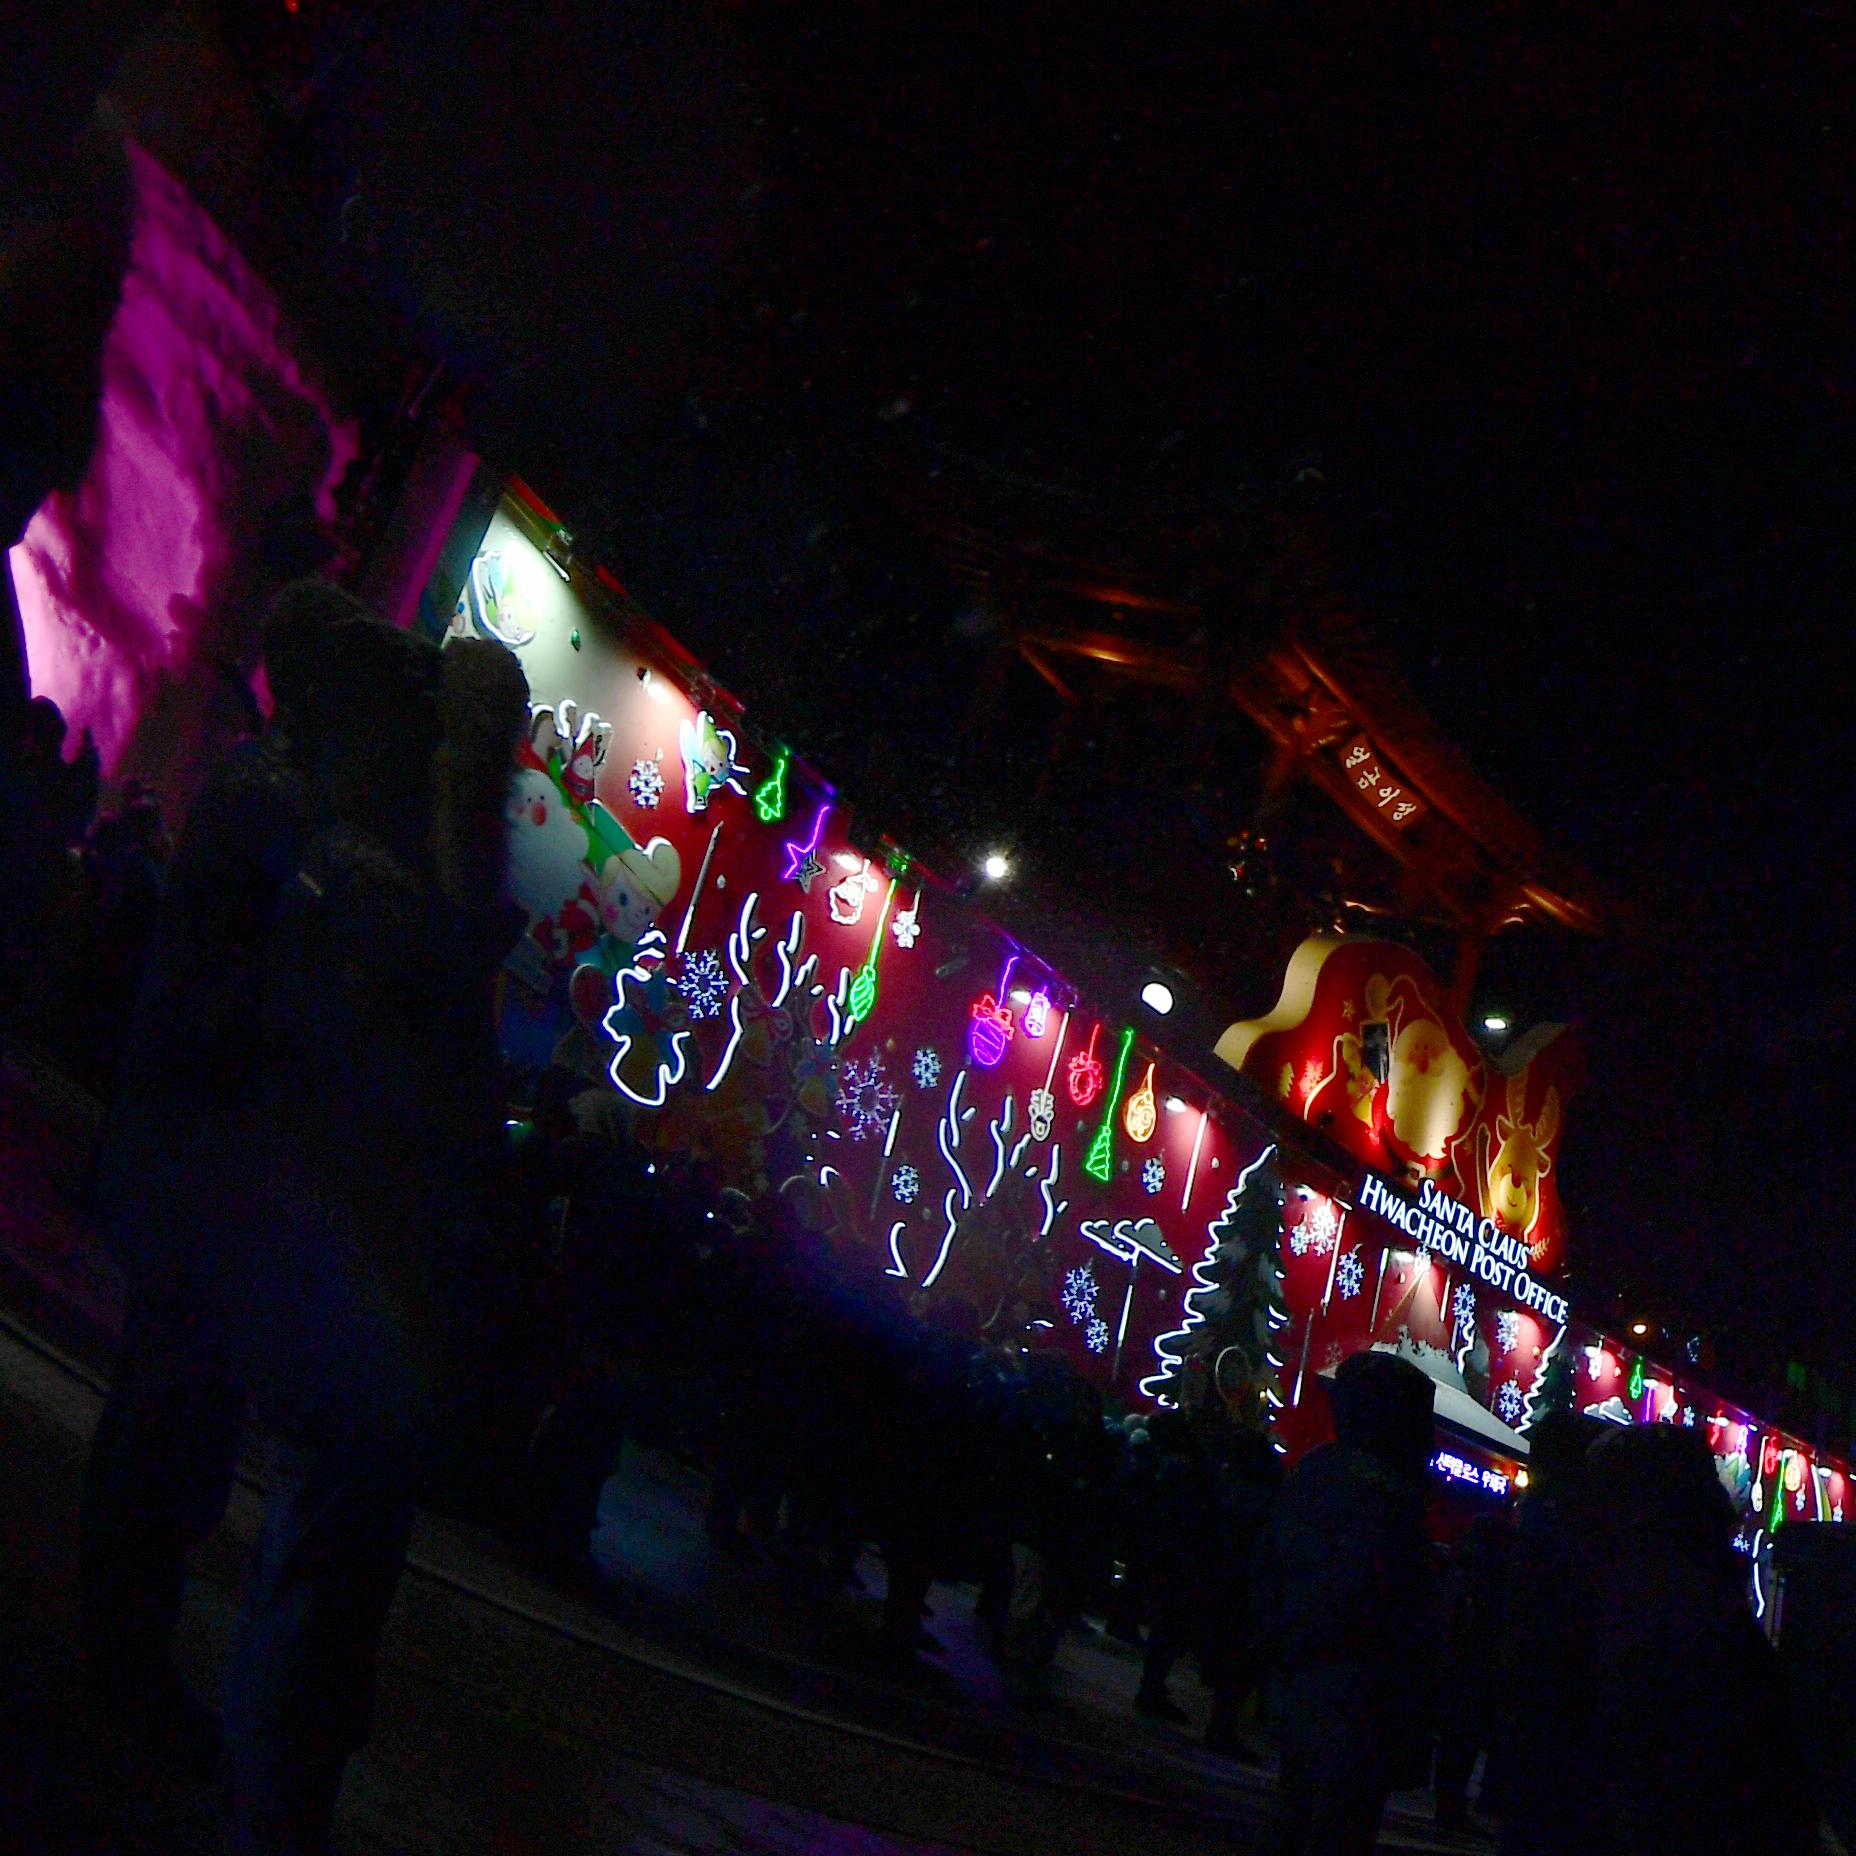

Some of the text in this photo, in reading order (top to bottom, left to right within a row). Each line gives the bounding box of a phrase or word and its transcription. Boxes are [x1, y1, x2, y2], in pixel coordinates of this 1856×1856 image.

[1345, 745, 1417, 821] 얼곰이성
[1419, 1178, 1474, 1239] SANTA
[1359, 1173, 1569, 1325] HWACHEON POST OFFICE
